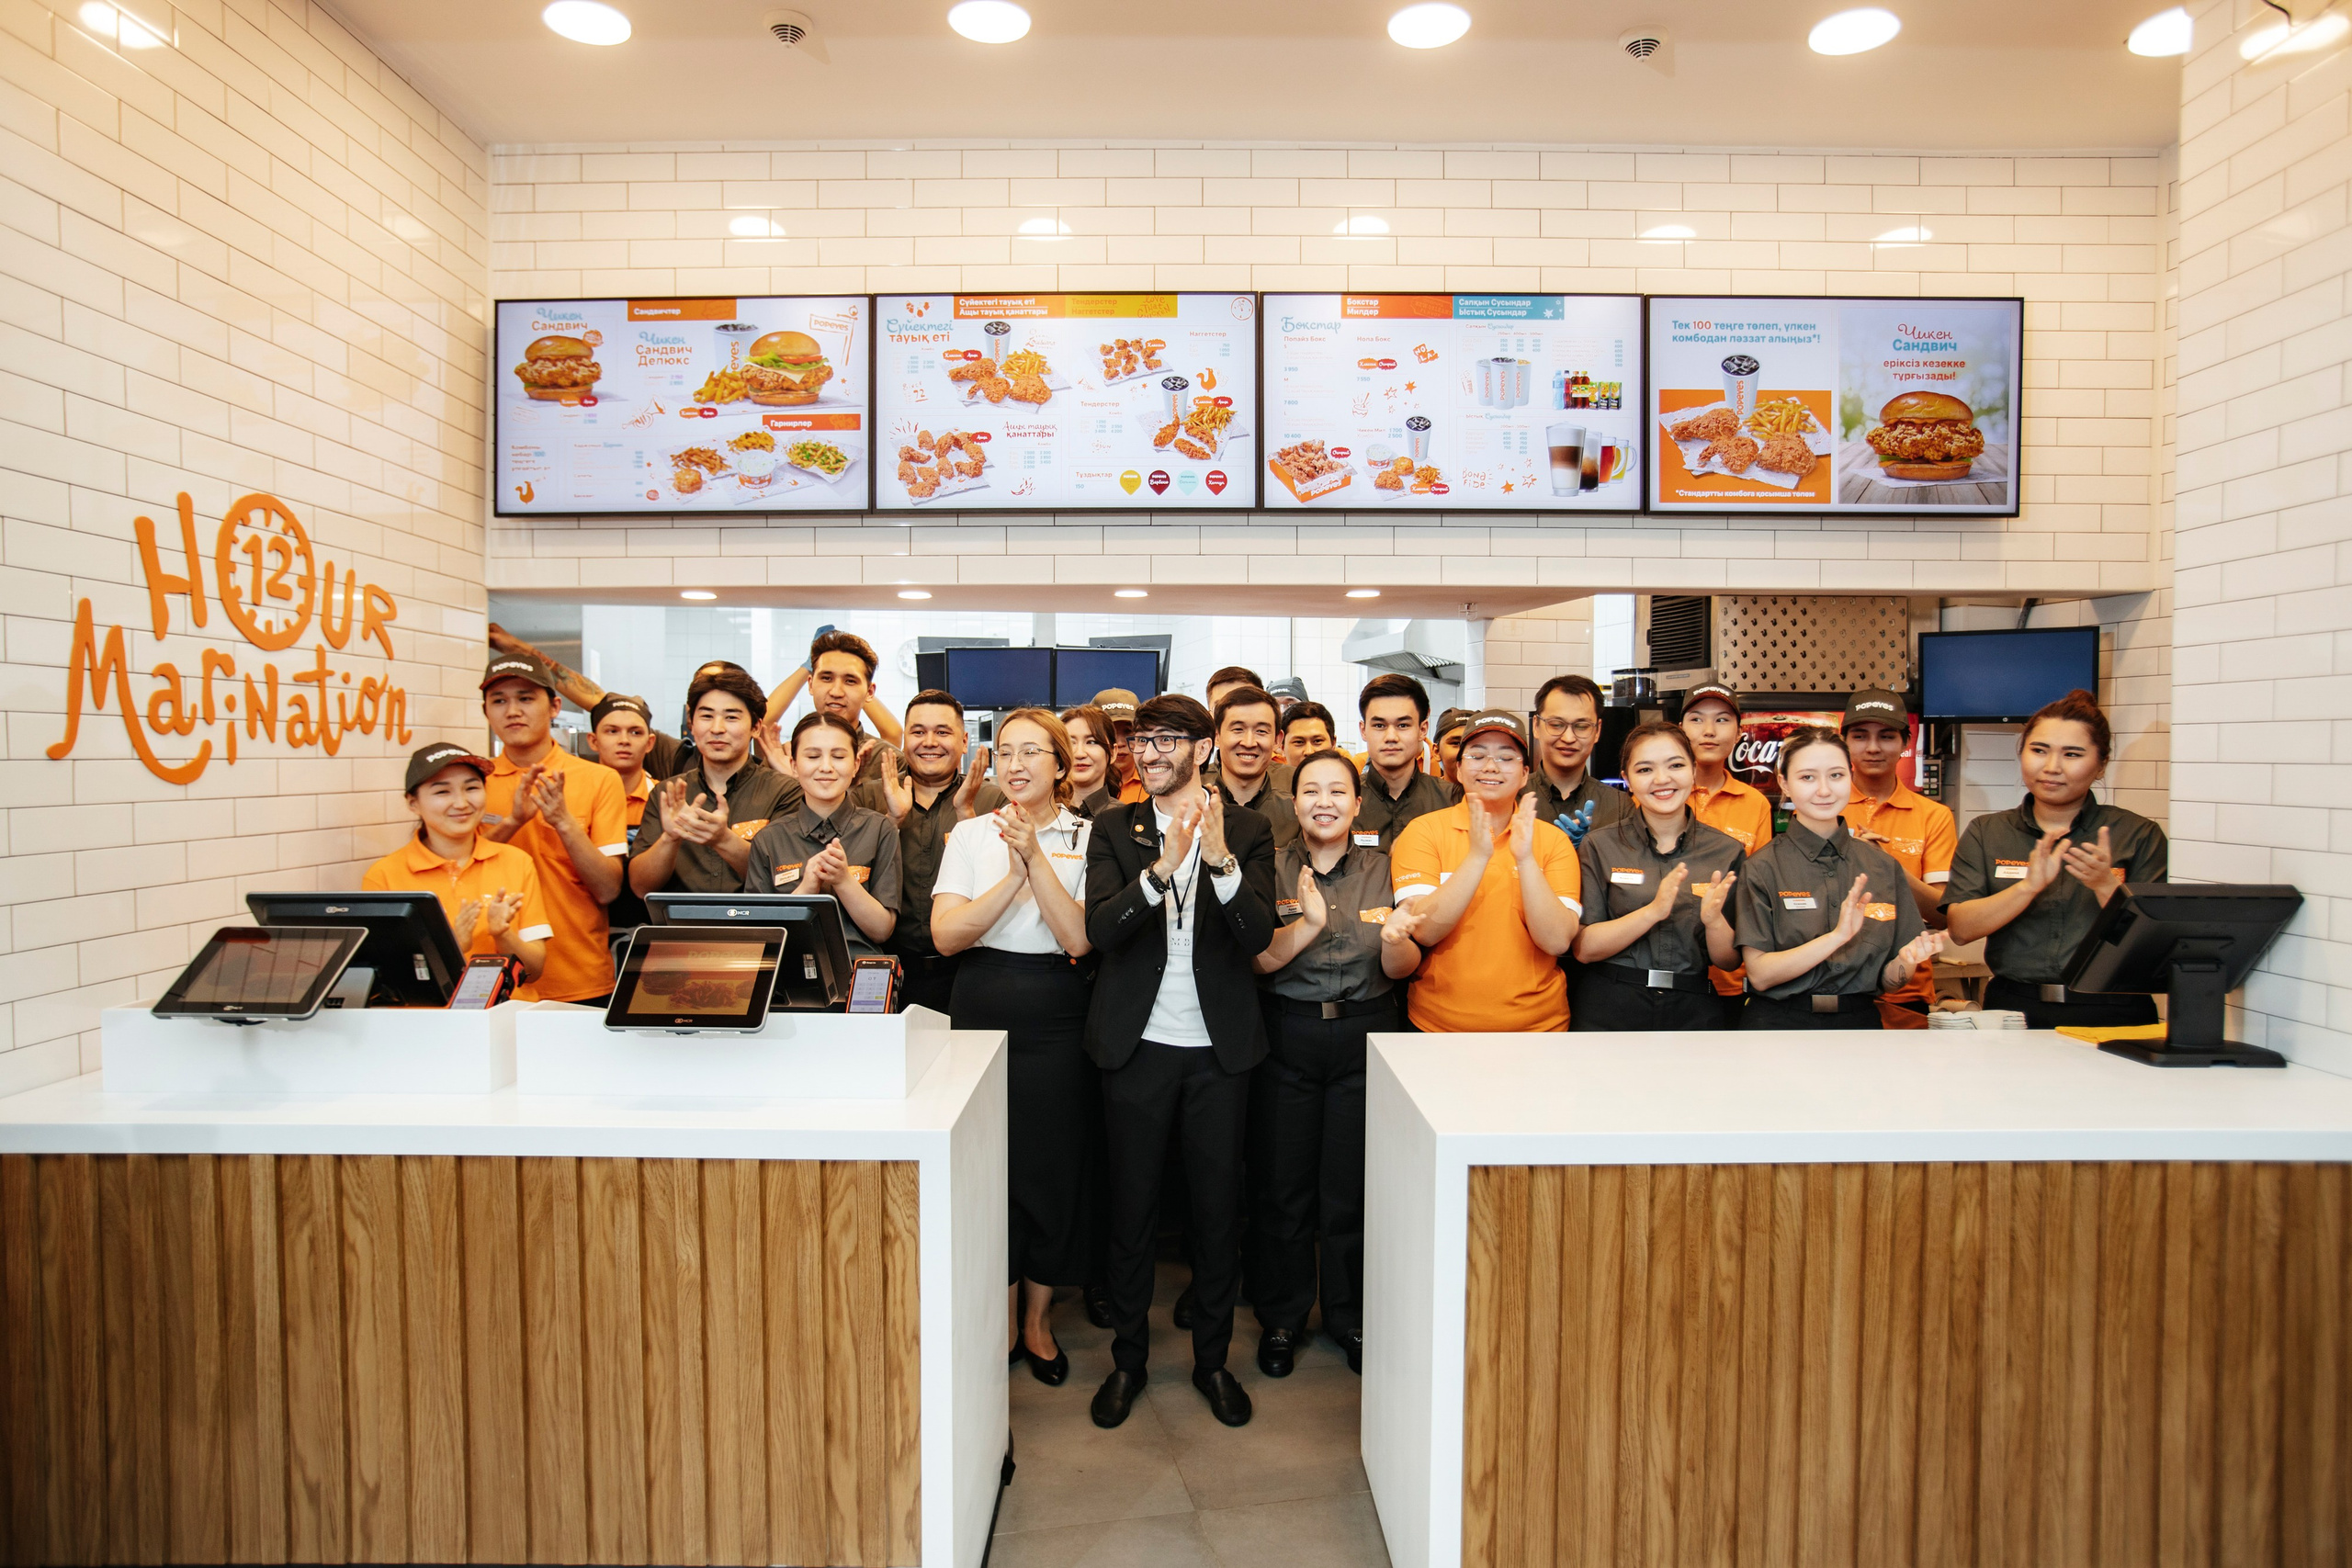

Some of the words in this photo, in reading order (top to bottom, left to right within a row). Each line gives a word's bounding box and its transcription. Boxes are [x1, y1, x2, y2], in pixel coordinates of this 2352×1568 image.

[959, 299, 999, 307] Сүйектегі
[1347, 299, 1379, 307] Бокстар
[1459, 299, 1489, 307] Салқын
[1491, 299, 1532, 308] Сусындар
[980, 309, 1004, 317] тауық
[1005, 309, 1048, 317] қанаттары
[1487, 309, 1527, 317] Сусындар
[532, 321, 588, 332] Сандвич
[887, 319, 954, 335] Сүйектегі
[1281, 317, 1341, 333] Бокстар
[1672, 321, 1690, 330] Тек
[1693, 321, 1712, 330] 100
[1713, 322, 1744, 332] теңге
[1747, 322, 1781, 332] төлеп,
[1784, 322, 1816, 333] үлкен
[1897, 323, 1952, 340] Чикен
[889, 333, 930, 344] тауық
[933, 332, 950, 343] еті
[1672, 333, 1727, 344] комбодан
[636, 344, 693, 355] Сандвич
[1893, 339, 1957, 353] Сандвич
[639, 355, 689, 367] Делюкс
[1883, 358, 1920, 369] еріксіз
[1923, 360, 1965, 368] кезекке
[1893, 371, 1956, 381] тұрғызады!
[1006, 431, 1055, 439] қанаттары
[134, 491, 397, 660] HOUR
[241, 534, 293, 606] 12
[1900, 749, 1912, 758] eal
